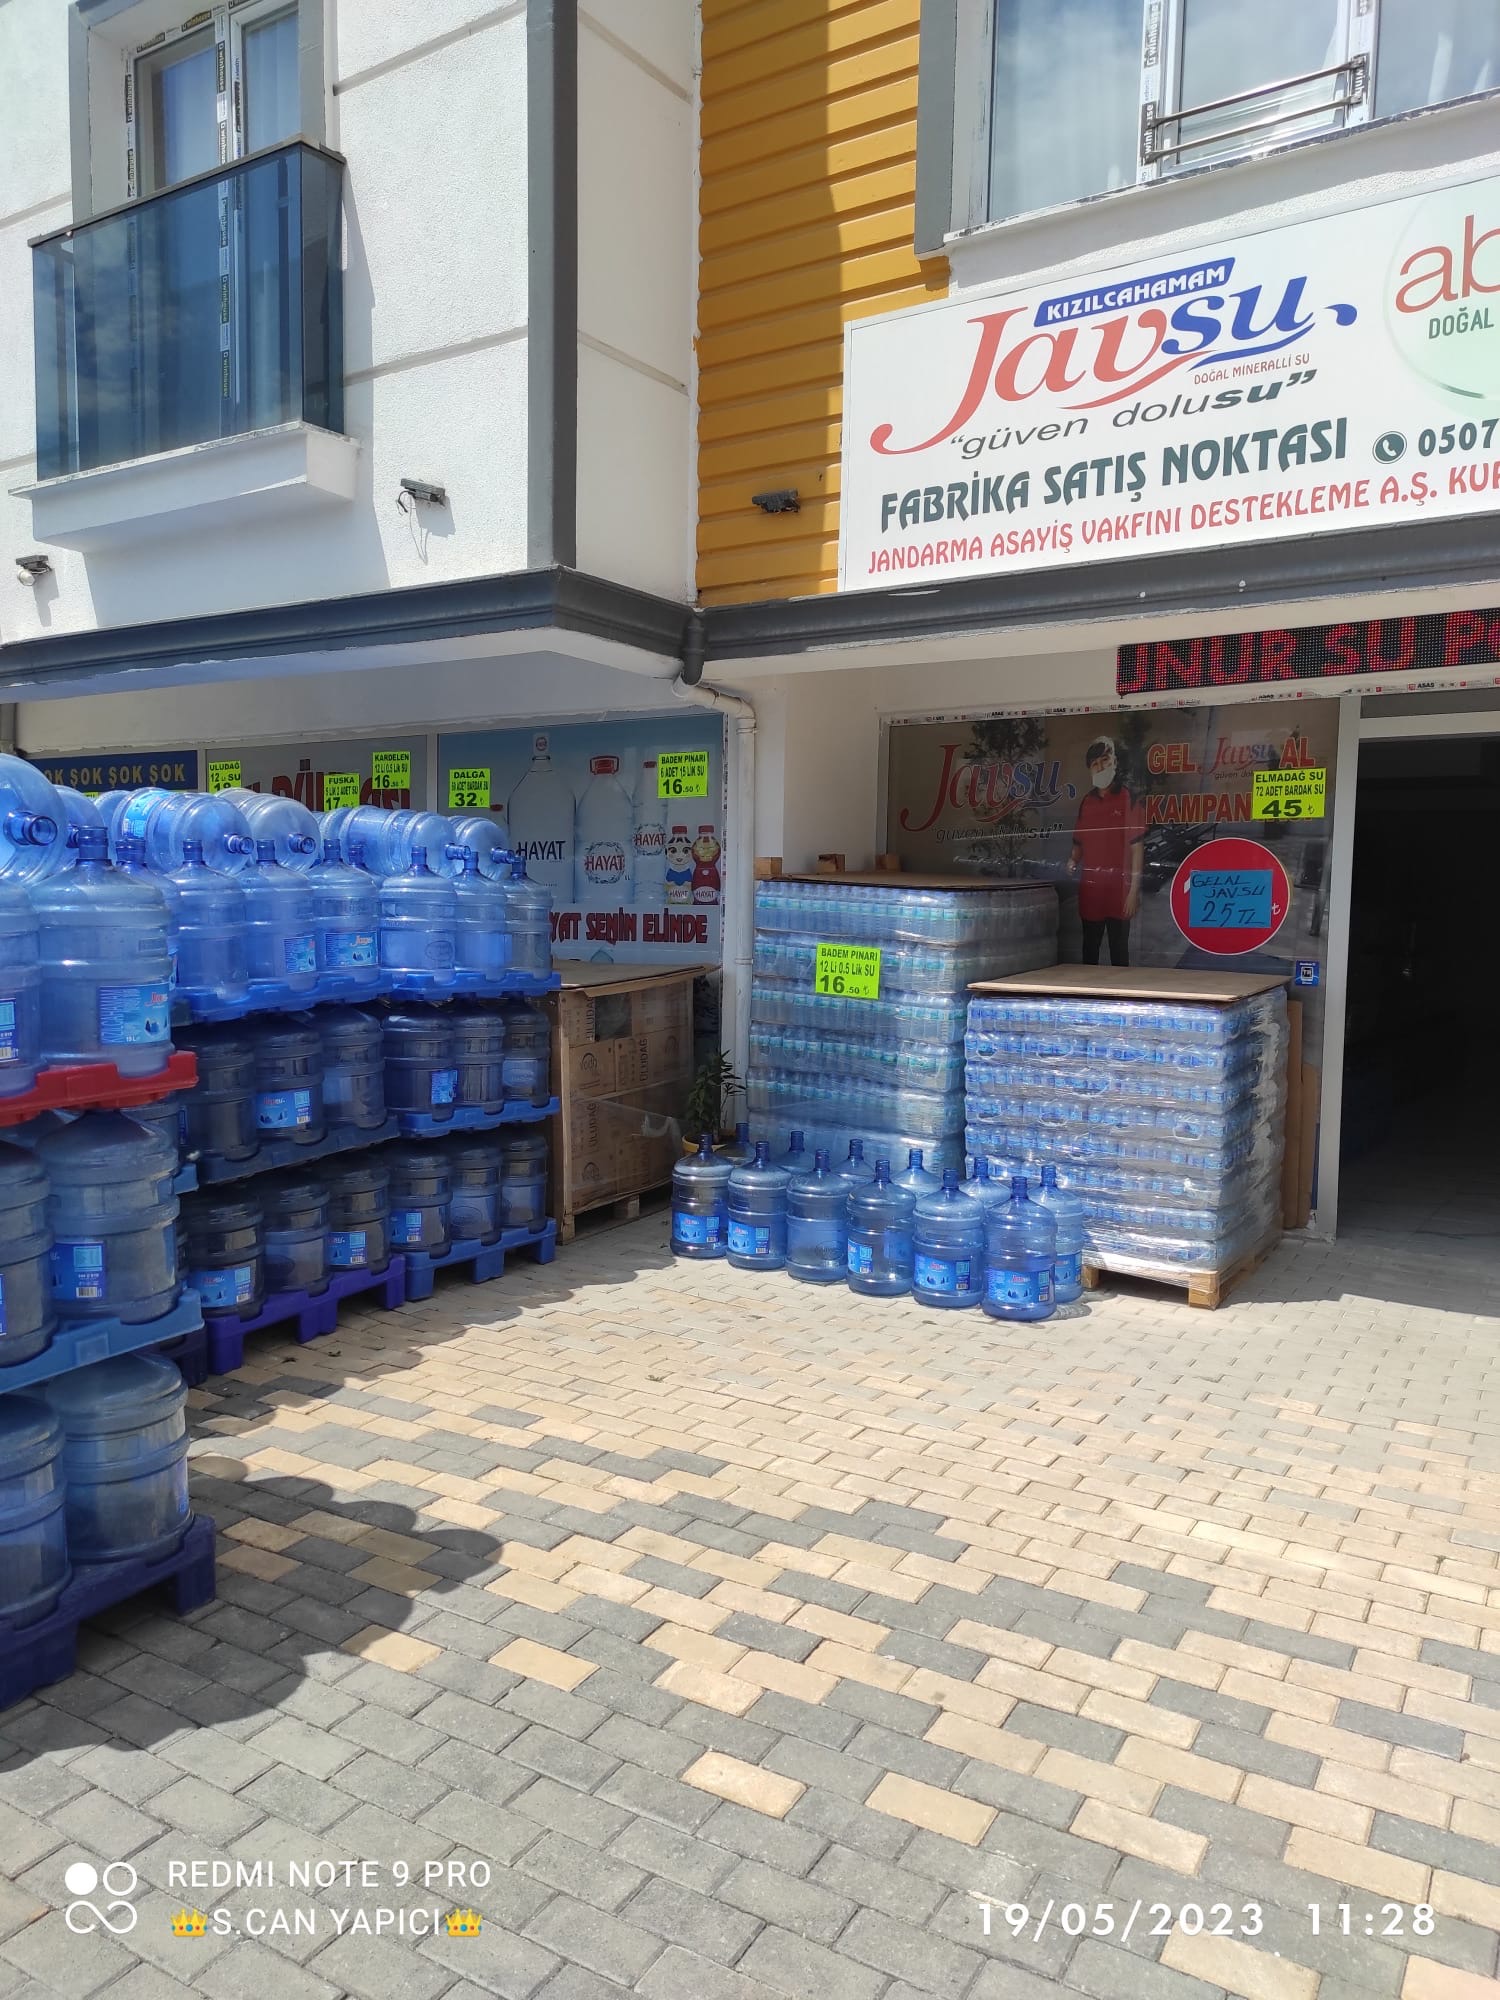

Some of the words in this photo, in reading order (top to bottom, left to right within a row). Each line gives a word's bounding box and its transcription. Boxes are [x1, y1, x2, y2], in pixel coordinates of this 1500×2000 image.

[1046, 265, 1226, 322] KIZILCAHAMAM
[1429, 306, 1495, 339] DOĞAL
[1194, 367, 1229, 385] DOĞAL
[1295, 352, 1310, 366] SU
[881, 470, 1030, 534] FABRİKA
[1043, 451, 1146, 503] SATIŞ
[1161, 417, 1348, 487] NOKTASI
[1417, 418, 1499, 457] 0507
[868, 536, 983, 574] JANDARMA
[990, 519, 1073, 554] ASAYİŞ
[1081, 507, 1182, 545] VAKFINI
[1190, 479, 1370, 530] DESTEKLEME
[1323, 616, 1416, 678] SU
[375, 753, 409, 761] KARDELEN
[661, 755, 683, 764] BADEM
[684, 754, 706, 763] PINARI
[1147, 743, 1196, 774] GEL
[1279, 736, 1316, 769] AL
[44, 768, 64, 785] OK
[70, 767, 102, 788] ŞOK
[108, 765, 143, 788] ŞOK
[149, 763, 185, 786] ŞOK
[211, 772, 220, 782] 12
[228, 773, 241, 781] SU
[328, 776, 355, 785] FUSKA
[453, 770, 485, 779] DALGA
[1255, 771, 1306, 783] ELMADAĞ
[1308, 770, 1324, 781] SU
[1256, 787, 1264, 796] 72
[1265, 785, 1283, 796] ADET
[1284, 784, 1312, 796] BARDAK
[1314, 784, 1324, 795] SU
[454, 792, 478, 806] 32
[1262, 799, 1303, 817] 45
[634, 831, 667, 846] HAYAT
[517, 840, 566, 861] HAYAT
[585, 855, 625, 871] HAYAT
[695, 890, 715, 899] HAYAT
[1201, 900, 1236, 927] 25
[1237, 908, 1265, 925] TL
[643, 907, 708, 944] ELİNDE
[821, 948, 849, 959] BADEM
[850, 951, 878, 961] PINARI
[820, 960, 829, 973] 12
[864, 964, 875, 977] SU
